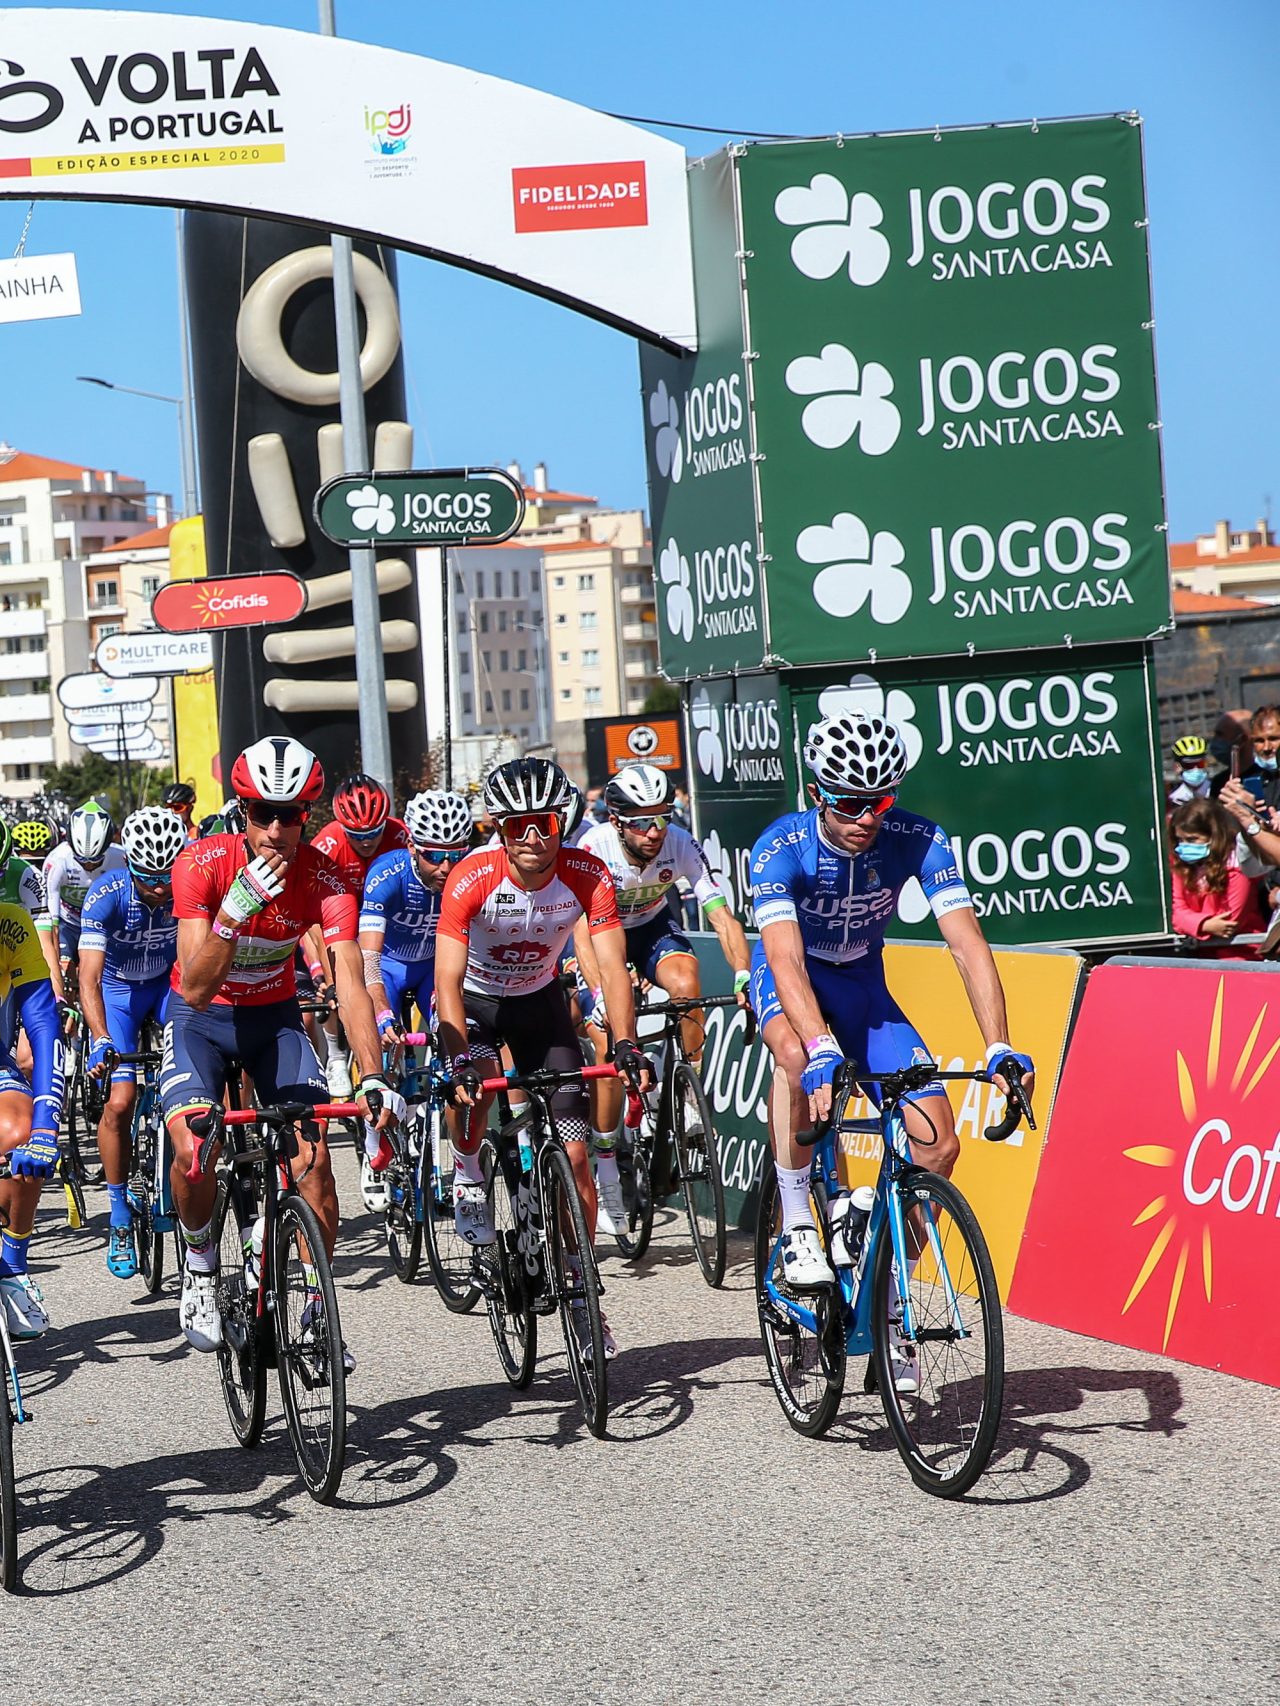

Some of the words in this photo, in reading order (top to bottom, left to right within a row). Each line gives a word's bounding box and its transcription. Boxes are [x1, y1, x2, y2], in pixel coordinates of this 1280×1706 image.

[70, 47, 280, 106] VOLTA
[78, 119, 100, 144] A
[109, 109, 283, 142] PORTUGAL
[57, 155, 123, 171] EDIÇÃO
[130, 152, 211, 167] ESPECIAL
[219, 149, 261, 161] 2020
[520, 181, 640, 204] FIDELIDADE
[907, 174, 1112, 267] JOGOS
[932, 240, 1114, 281] SANTACASA
[917, 343, 1122, 437] JOGOS
[685, 372, 744, 464] JOGOS
[942, 409, 1124, 450] SANTACASA
[693, 437, 747, 478] SANTACASA
[401, 491, 492, 529] JOGOS
[412, 519, 491, 534] SANTACASA
[928, 512, 1133, 605] JOGOS
[208, 592, 268, 611] Cofidis
[695, 540, 755, 625] JOGOS
[954, 578, 1135, 619] SANTACASA
[704, 602, 758, 639] SANTACASA
[120, 642, 208, 658] MULTICARE
[936, 671, 1120, 756] JOGOS
[725, 700, 781, 770] JOGOS
[959, 729, 1121, 768] SANTACASA
[733, 751, 784, 784] SANTACASA
[753, 827, 808, 874] BOLFLEX
[83, 878, 126, 911] BOLFLEX
[366, 860, 406, 894] BOLFLEX
[495, 894, 515, 903] P&R
[757, 908, 793, 925] Opticenter
[828, 904, 894, 931] Porto
[482, 962, 544, 972] BOAVISTA
